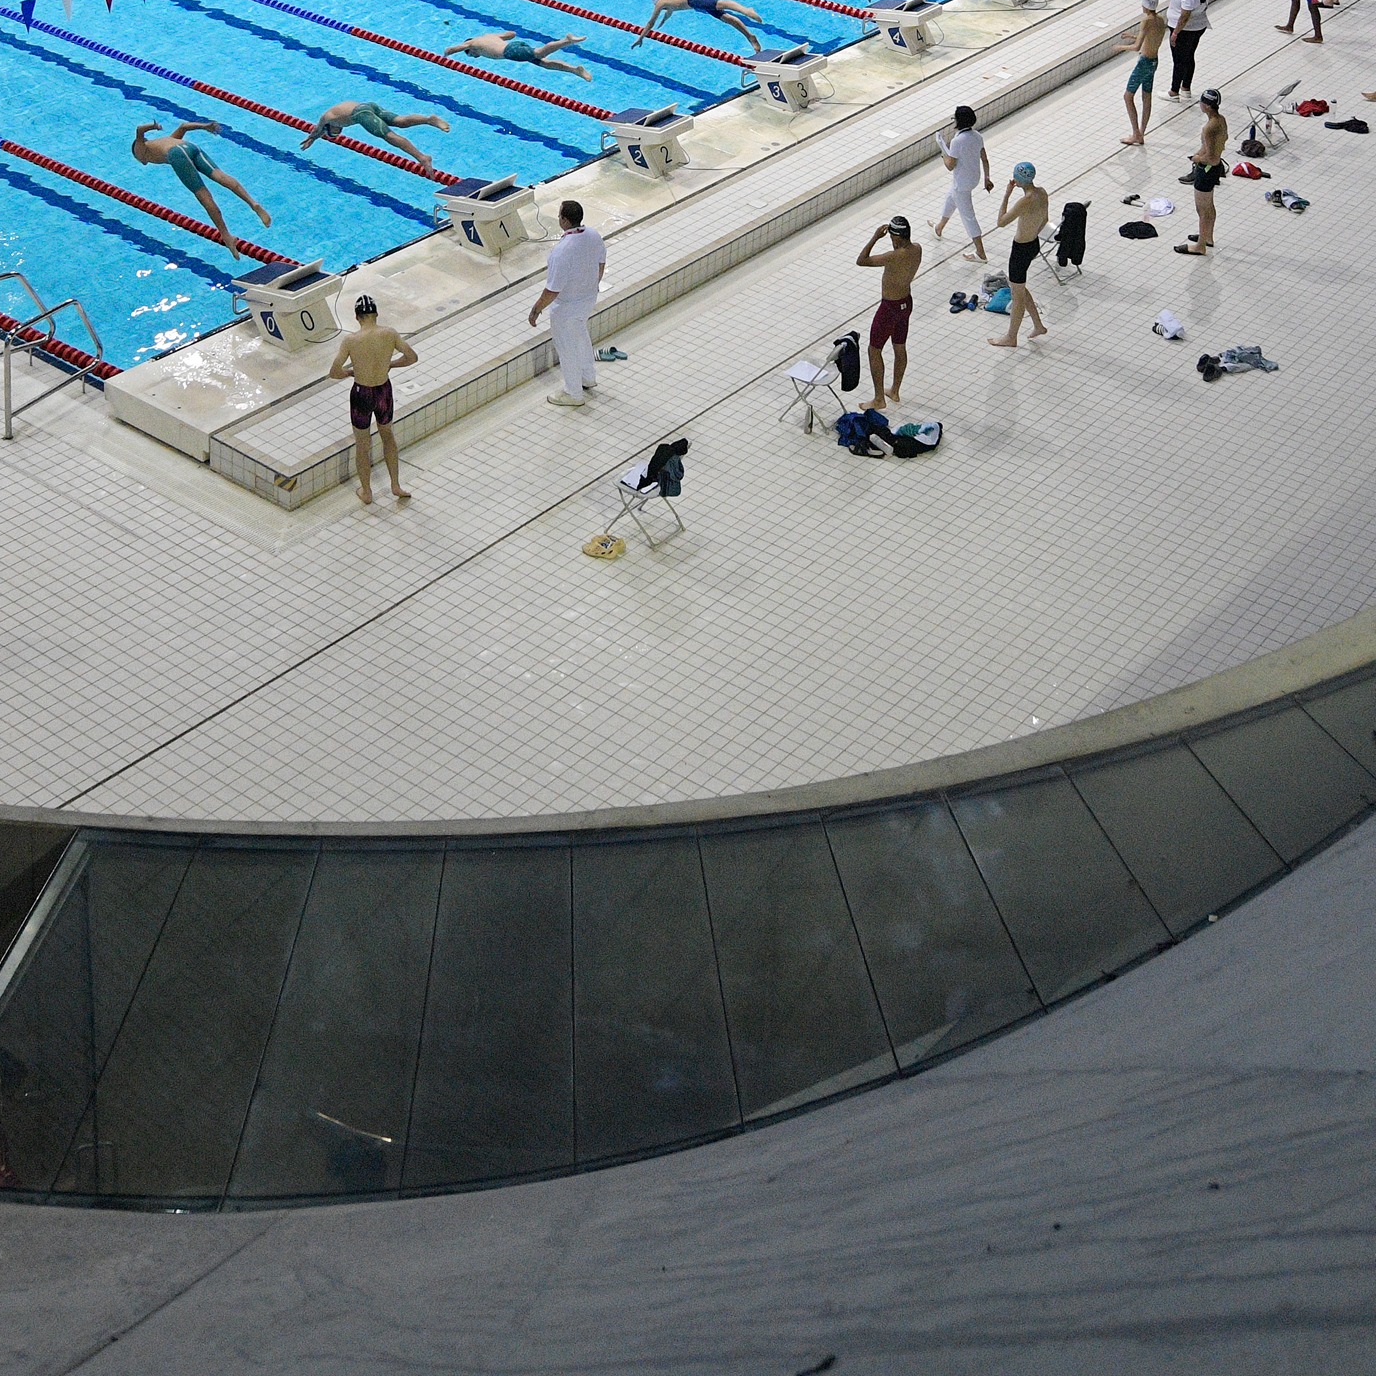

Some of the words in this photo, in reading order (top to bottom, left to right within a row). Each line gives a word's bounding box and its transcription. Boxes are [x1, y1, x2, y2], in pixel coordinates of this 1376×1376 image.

[892, 31, 900, 43] 4
[916, 29, 924, 43] 4
[772, 85, 780, 98] 3
[797, 82, 808, 98] 3
[634, 149, 642, 164] 2
[660, 146, 673, 164] 2
[468, 226, 475, 240] 1
[499, 220, 510, 238] 1
[266, 316, 275, 333] 0
[300, 310, 315, 331] 0
